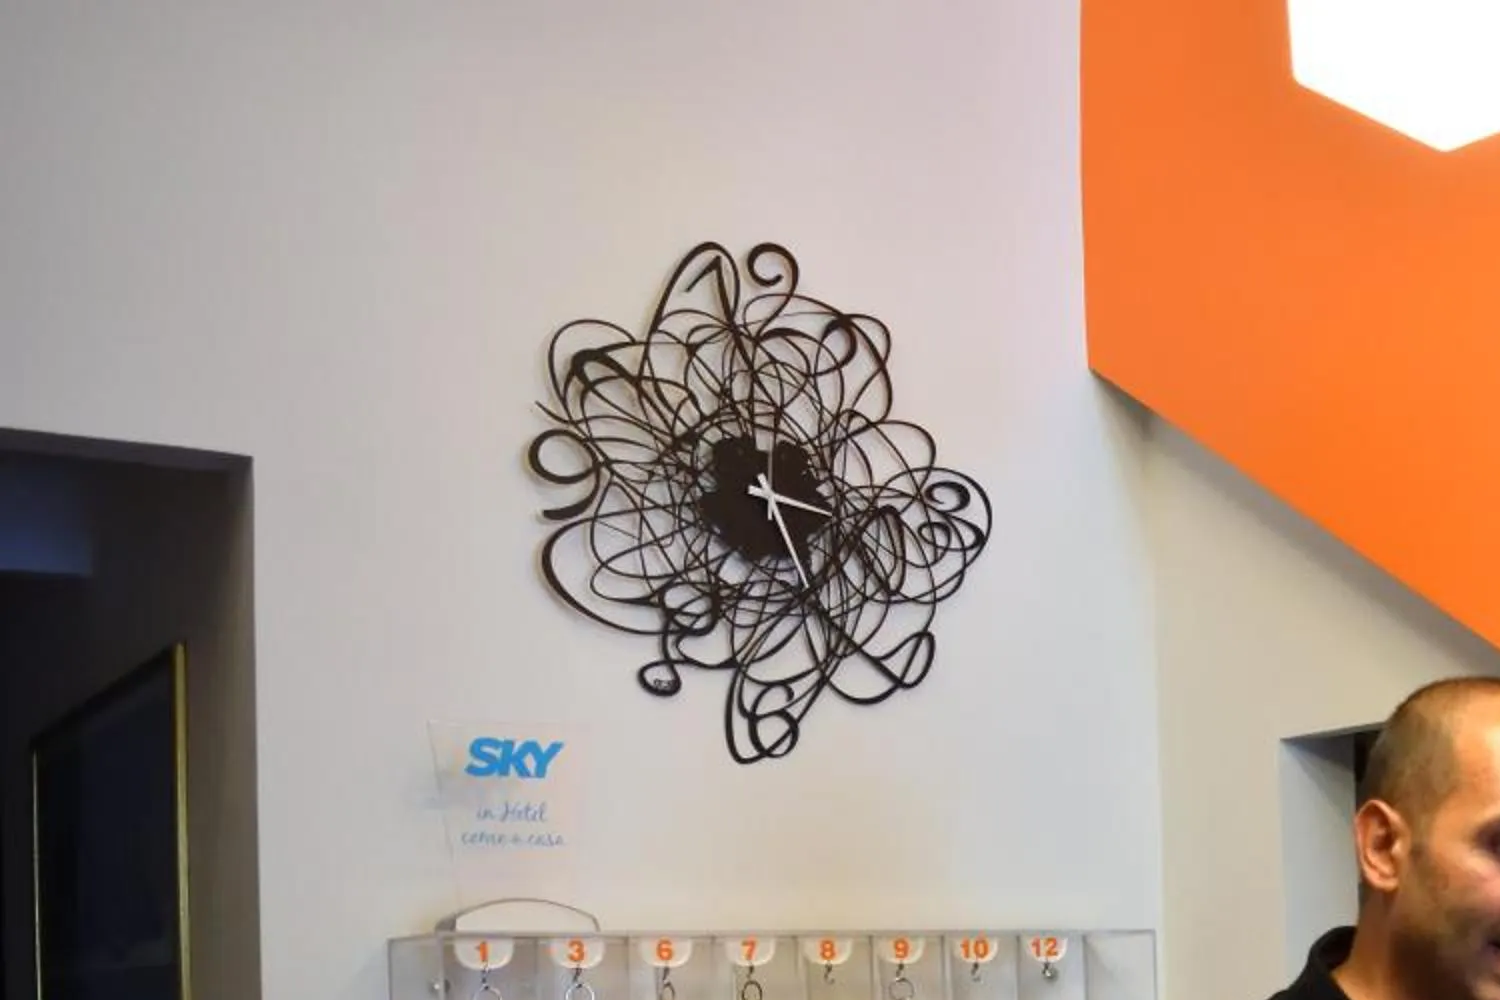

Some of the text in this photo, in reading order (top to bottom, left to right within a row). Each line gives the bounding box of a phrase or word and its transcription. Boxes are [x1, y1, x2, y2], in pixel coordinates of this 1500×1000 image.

[464, 735, 566, 779] SKY
[476, 941, 490, 962] 1
[567, 940, 586, 963] 3
[655, 938, 675, 962] 6
[740, 937, 758, 961] 7
[818, 938, 838, 961] 8
[891, 938, 911, 960] 9
[960, 937, 991, 960] 10
[1030, 937, 1057, 958] 12
